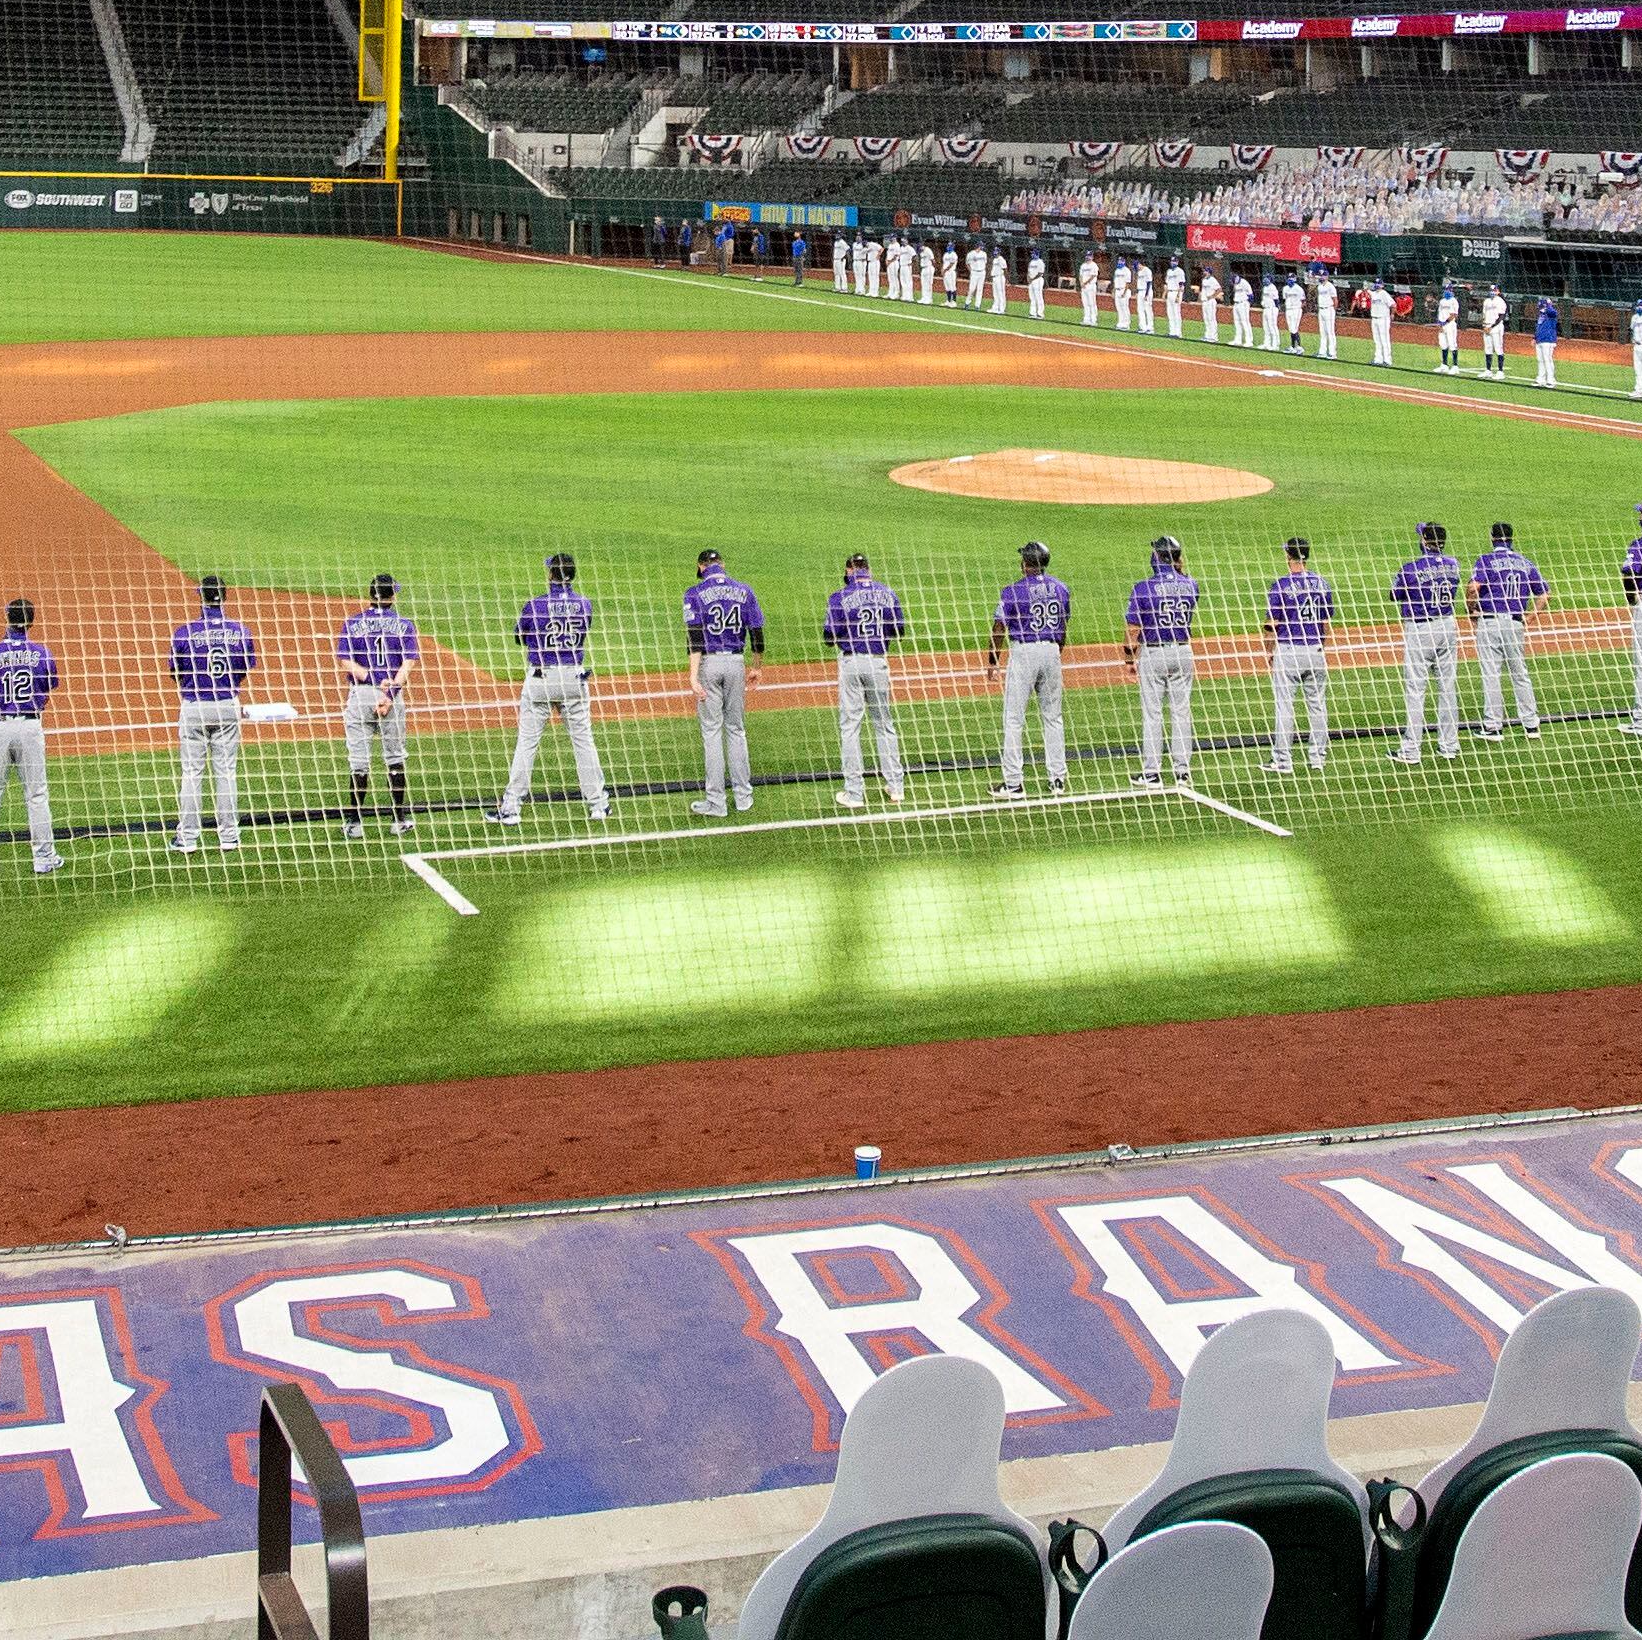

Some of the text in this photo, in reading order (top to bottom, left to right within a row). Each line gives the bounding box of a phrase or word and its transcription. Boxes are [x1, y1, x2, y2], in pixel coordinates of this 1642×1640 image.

[1243, 20, 1301, 38] Academy
[1352, 16, 1399, 36] Academy
[1455, 13, 1506, 34] Academy
[1566, 9, 1622, 29] Academy
[35, 193, 106, 206] SOUTHWEST
[1431, 581, 1453, 608] 16
[1506, 572, 1522, 599] 11
[707, 603, 742, 635] 34
[857, 608, 884, 637] 21
[1029, 601, 1061, 632] 39
[1158, 599, 1192, 627] 53
[544, 620, 583, 650] 25
[208, 648, 227, 678] 6
[373, 635, 386, 667] 1
[2, 670, 33, 704] 12
